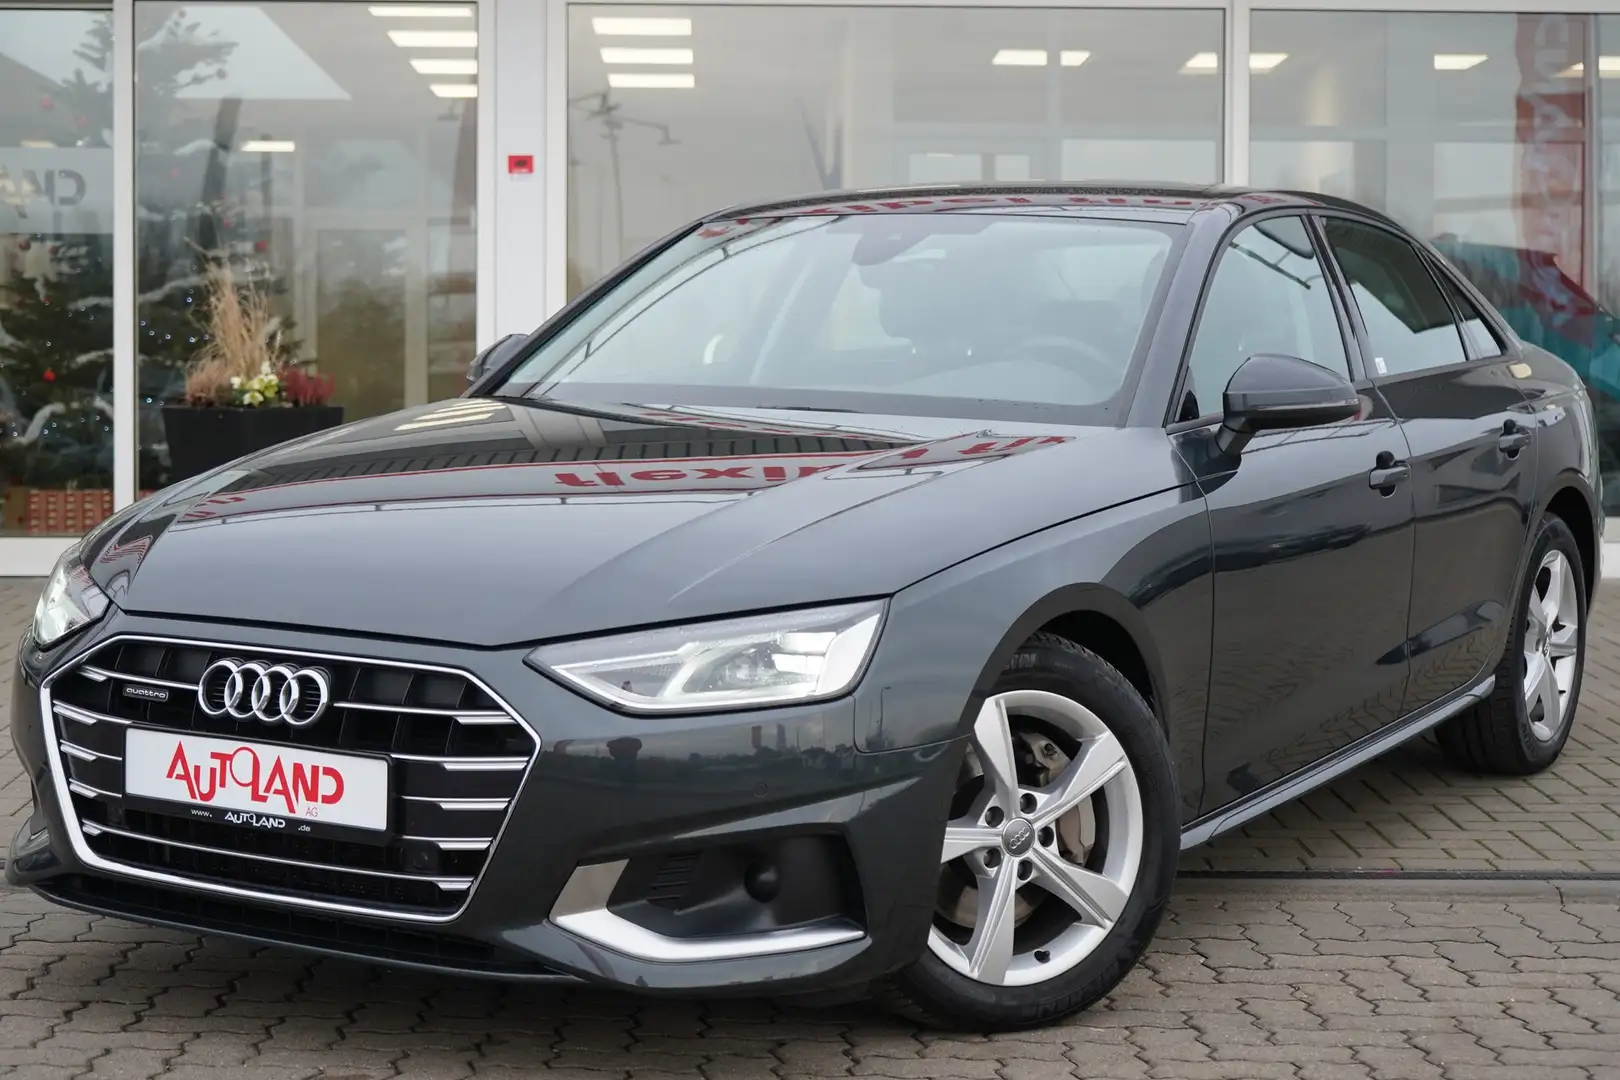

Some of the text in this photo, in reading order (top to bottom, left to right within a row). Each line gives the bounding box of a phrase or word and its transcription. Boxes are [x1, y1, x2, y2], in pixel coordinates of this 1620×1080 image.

[126, 687, 166, 699] quattro
[190, 808, 213, 818] www.
[305, 806, 318, 818] AG
